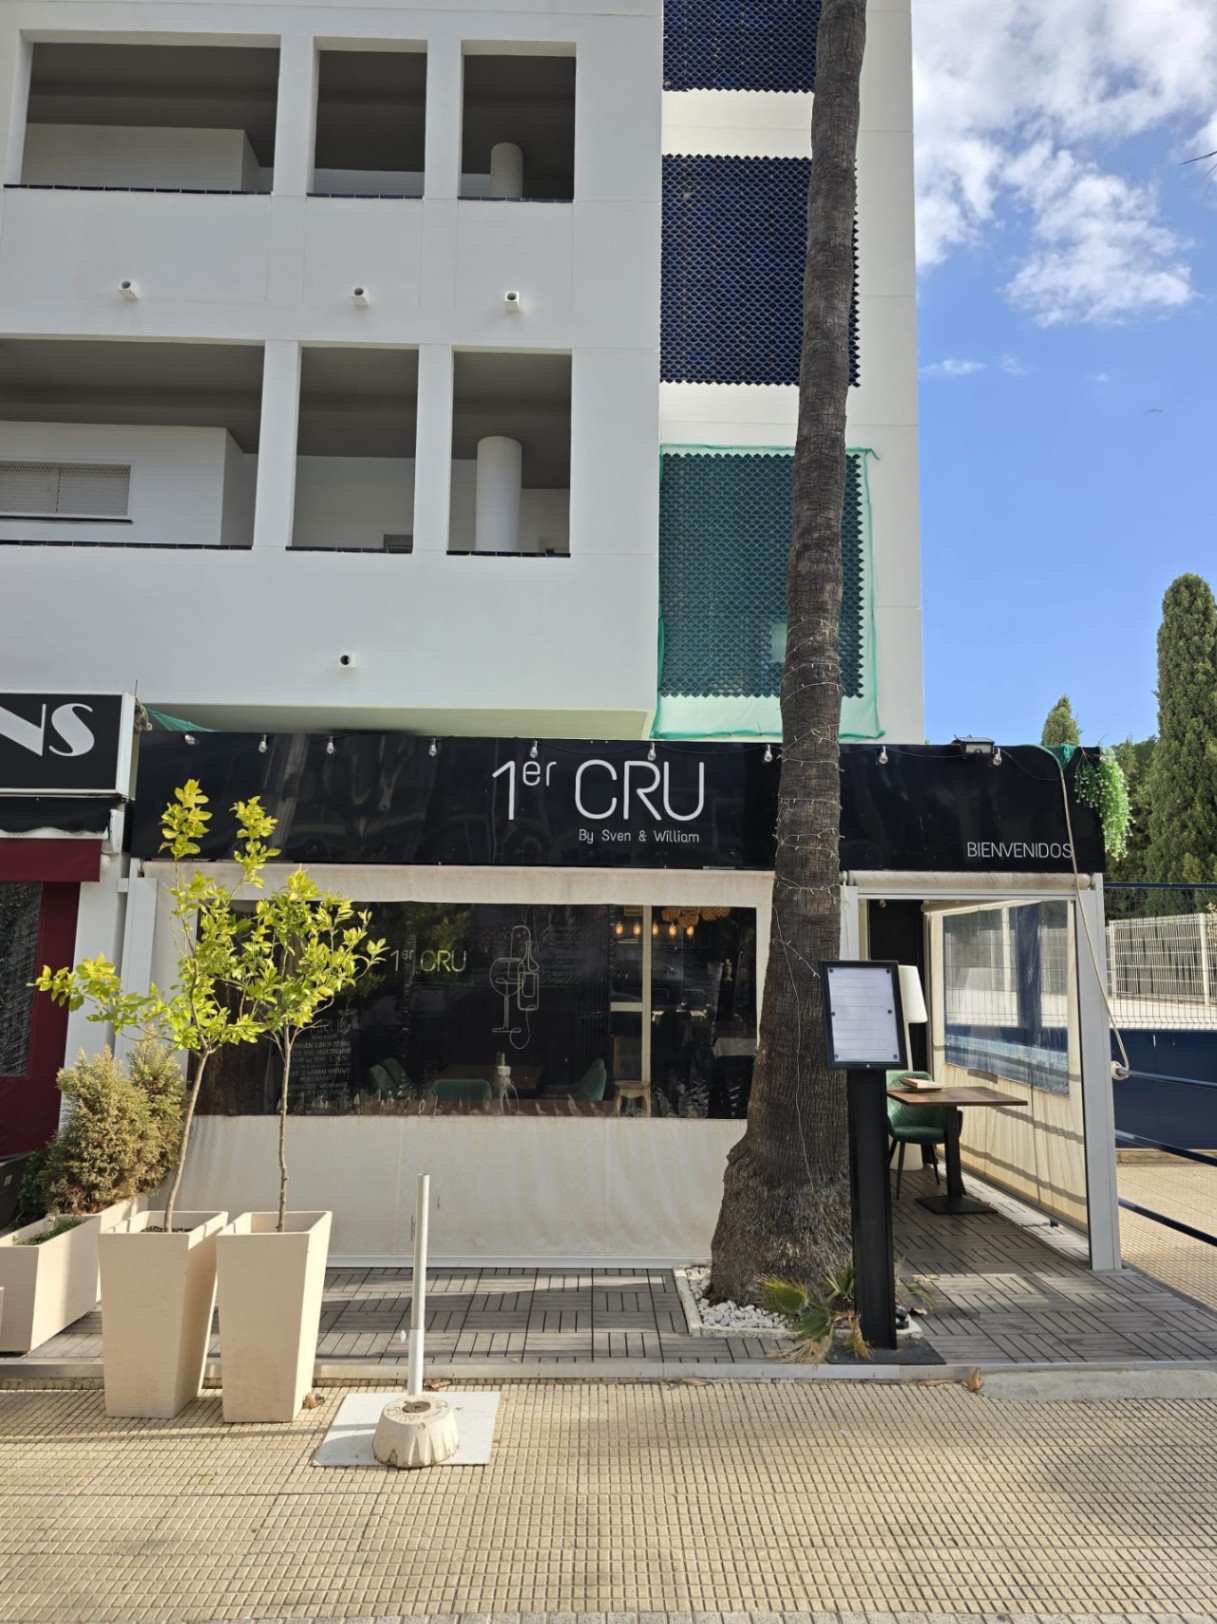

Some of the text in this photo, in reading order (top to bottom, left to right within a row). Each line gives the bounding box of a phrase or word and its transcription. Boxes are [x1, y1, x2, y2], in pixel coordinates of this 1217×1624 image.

[492, 759, 705, 822] 1er CRU
[578, 829, 700, 844] By Sven & William
[966, 841, 1074, 859] BIENVENIDOS
[420, 949, 467, 972] CRU
